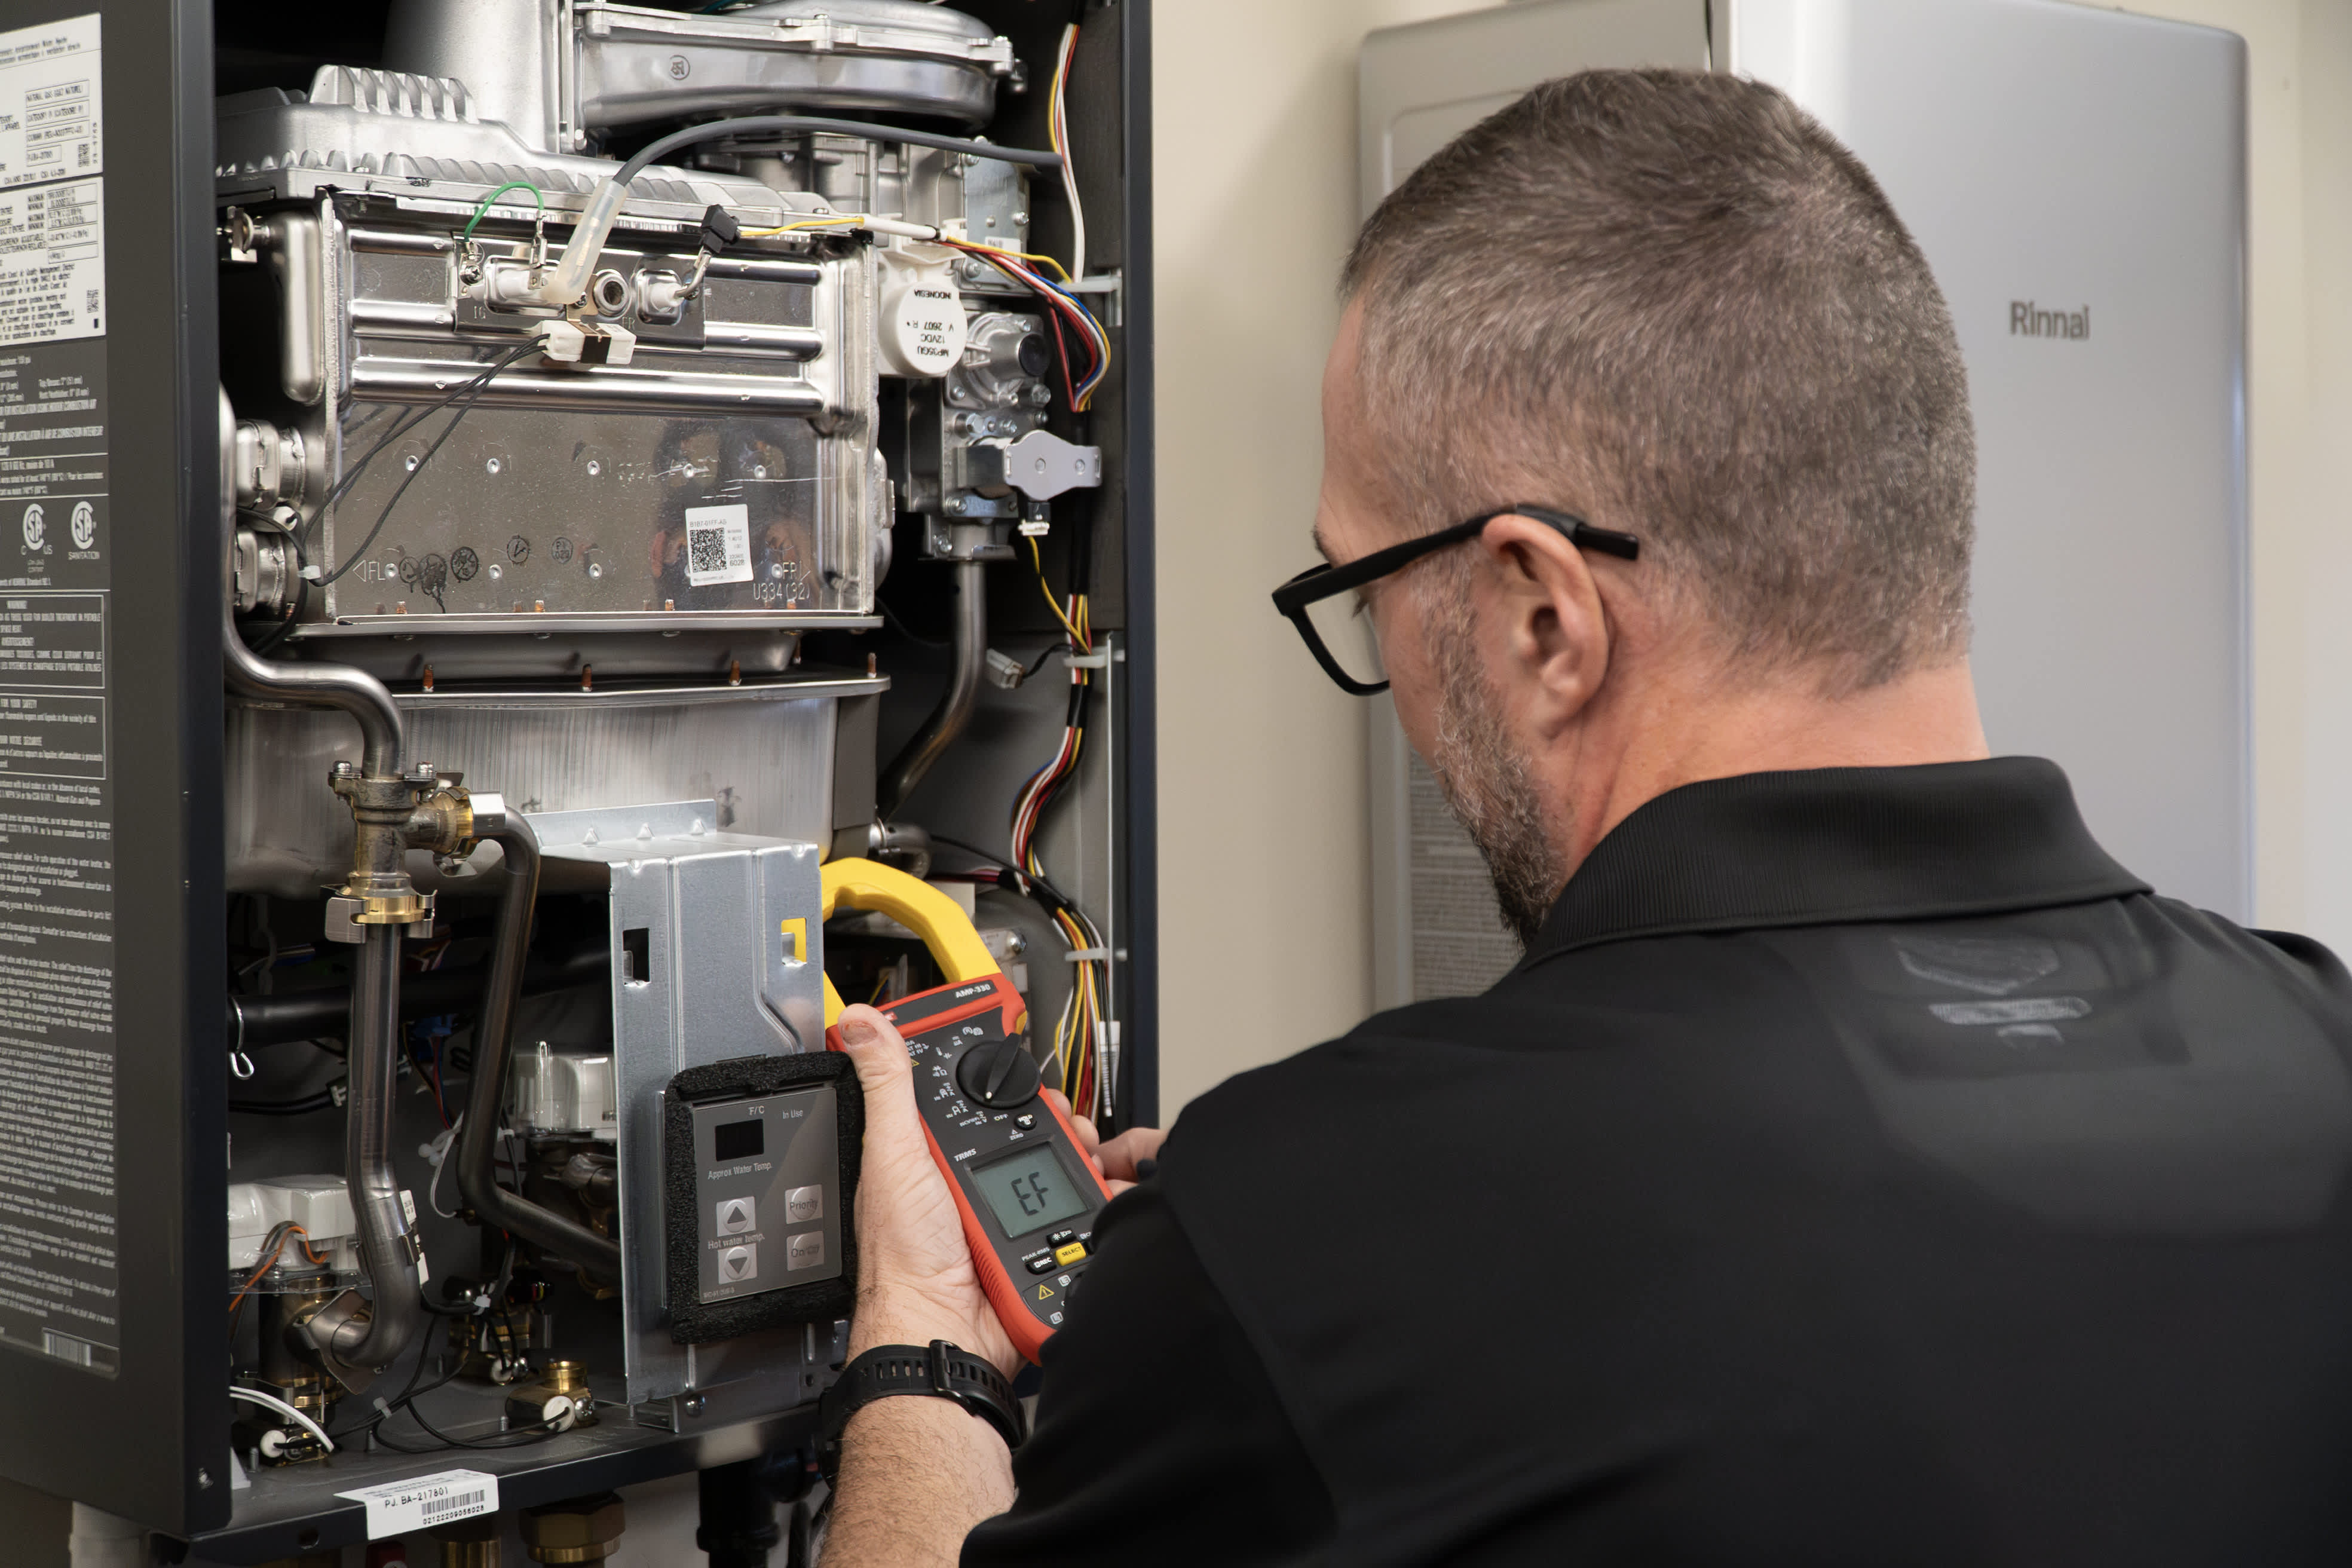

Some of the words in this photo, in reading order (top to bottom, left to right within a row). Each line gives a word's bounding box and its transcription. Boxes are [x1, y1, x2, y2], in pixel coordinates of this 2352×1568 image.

[914, 290, 951, 299] INDONESIA
[2009, 300, 2090, 341] Rinnai
[921, 333, 945, 344] 12VDC
[369, 561, 386, 580] FL
[955, 984, 991, 999] AMP-330
[783, 1110, 789, 1119] In
[791, 1110, 804, 1118] Use
[1018, 1114, 1033, 1122] HOLD
[954, 1148, 977, 1162] TRMS
[708, 1169, 732, 1180] Approx
[733, 1165, 752, 1175] Water
[1010, 1172, 1049, 1216] EF
[789, 1199, 818, 1211] Priority
[708, 1239, 721, 1250] Hot
[722, 1236, 742, 1246] water
[745, 1233, 765, 1243] temp.
[1062, 1247, 1082, 1257] SELECT
[385, 1499, 397, 1509] PJ.
[402, 1487, 448, 1505] BA-217801
